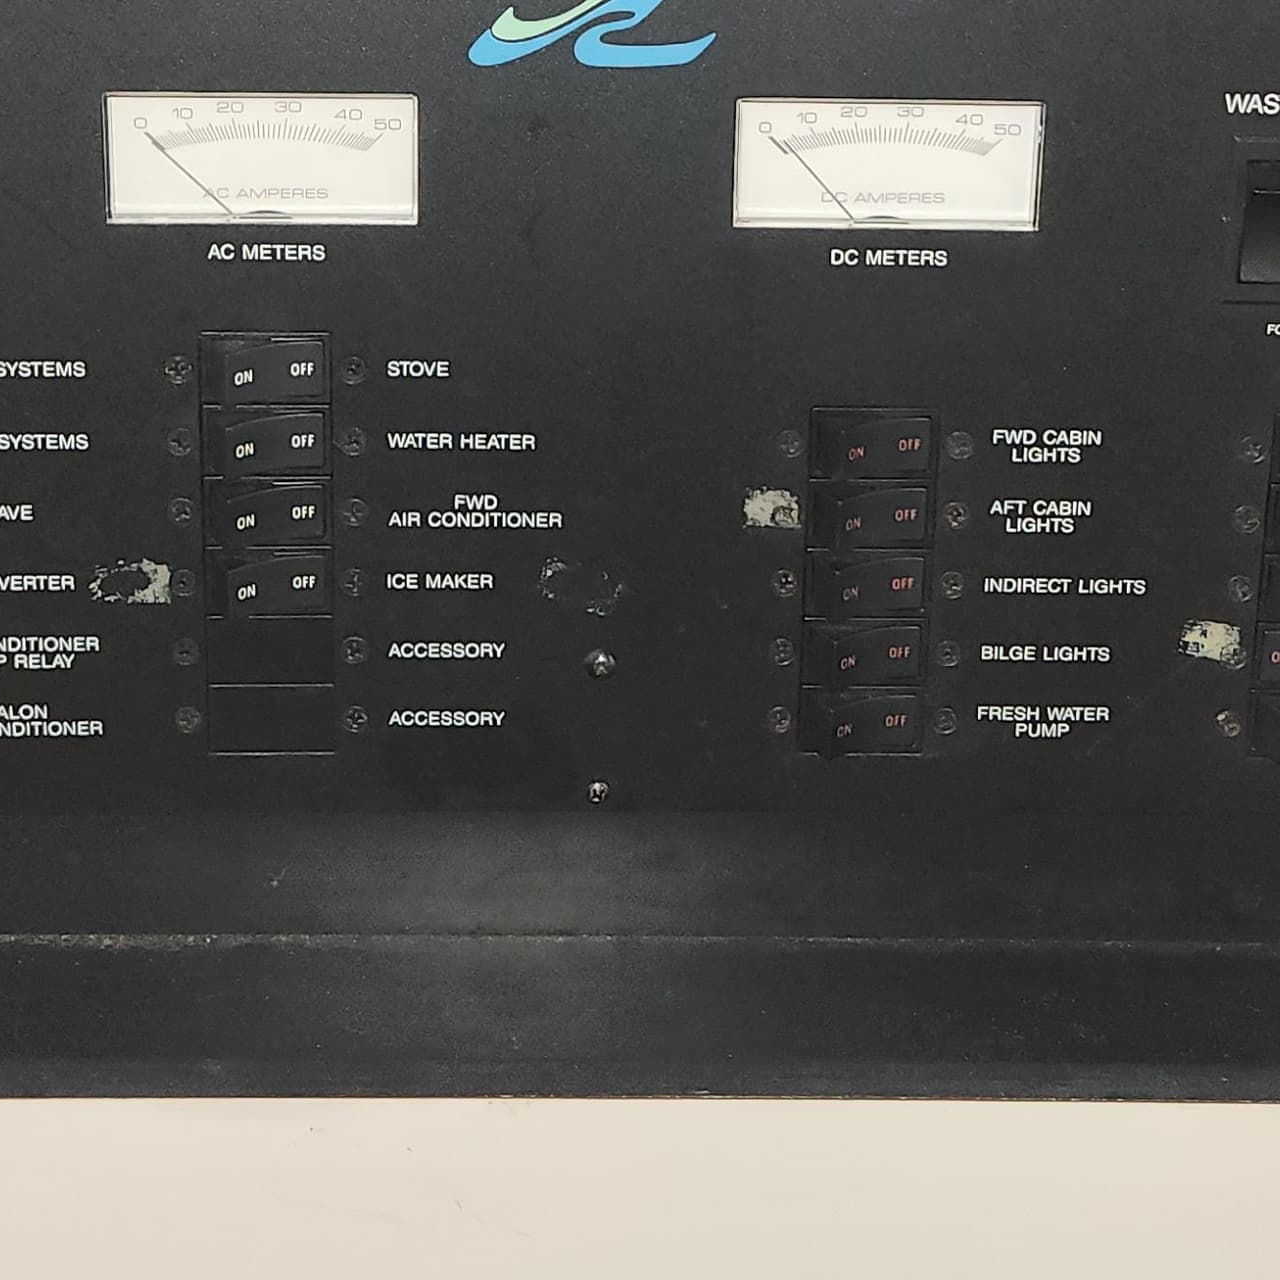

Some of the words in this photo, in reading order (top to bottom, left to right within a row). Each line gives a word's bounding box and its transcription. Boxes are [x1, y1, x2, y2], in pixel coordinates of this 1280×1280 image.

[831, 249, 858, 265] DC
[866, 250, 947, 266] METERS
[388, 361, 449, 376] STOVE
[388, 433, 452, 448] WATER
[461, 434, 535, 449] HEATER
[993, 430, 1036, 444] FWD
[1043, 430, 1101, 445] CABIN
[1012, 447, 1080, 462] LIGHTS
[388, 574, 418, 589] ICE
[426, 574, 492, 588] MAKER
[985, 578, 1072, 593] INDIRECT
[1079, 579, 1145, 594] LIGHTS
[389, 643, 504, 657] ACCESSORY
[14, 654, 74, 668] RELAY
[978, 706, 1039, 720] FRESH
[1047, 707, 1109, 721] WATER
[1016, 723, 1069, 737] PUMP
